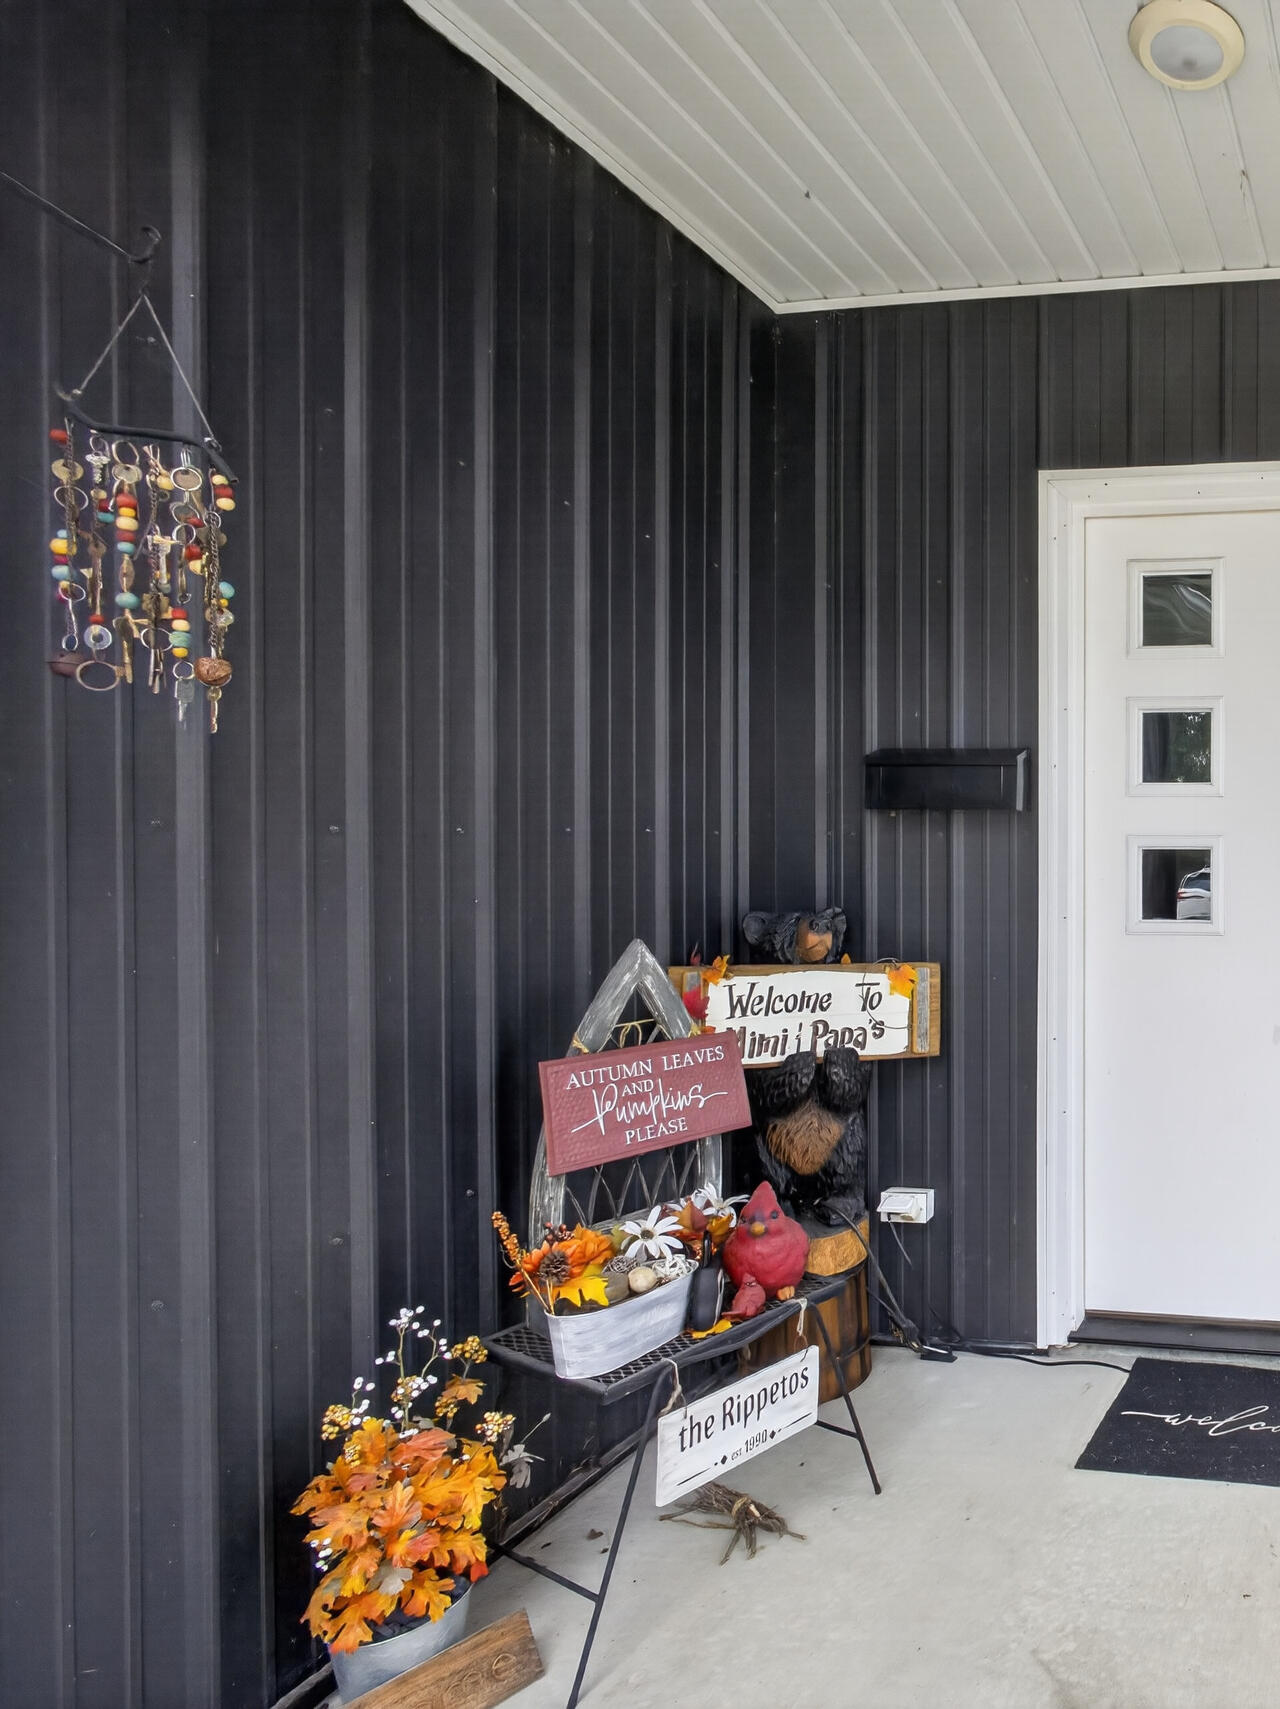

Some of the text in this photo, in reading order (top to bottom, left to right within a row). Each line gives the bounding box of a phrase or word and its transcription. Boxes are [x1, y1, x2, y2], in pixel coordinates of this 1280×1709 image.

[722, 982, 883, 1019] Welcome To
[565, 1045, 725, 1090] AUTUMN LEAVES
[571, 1078, 728, 1136] Pumpkins
[621, 1079, 654, 1098] AND
[625, 1117, 688, 1145] PLEASE
[679, 1366, 809, 1452] the Rippetos
